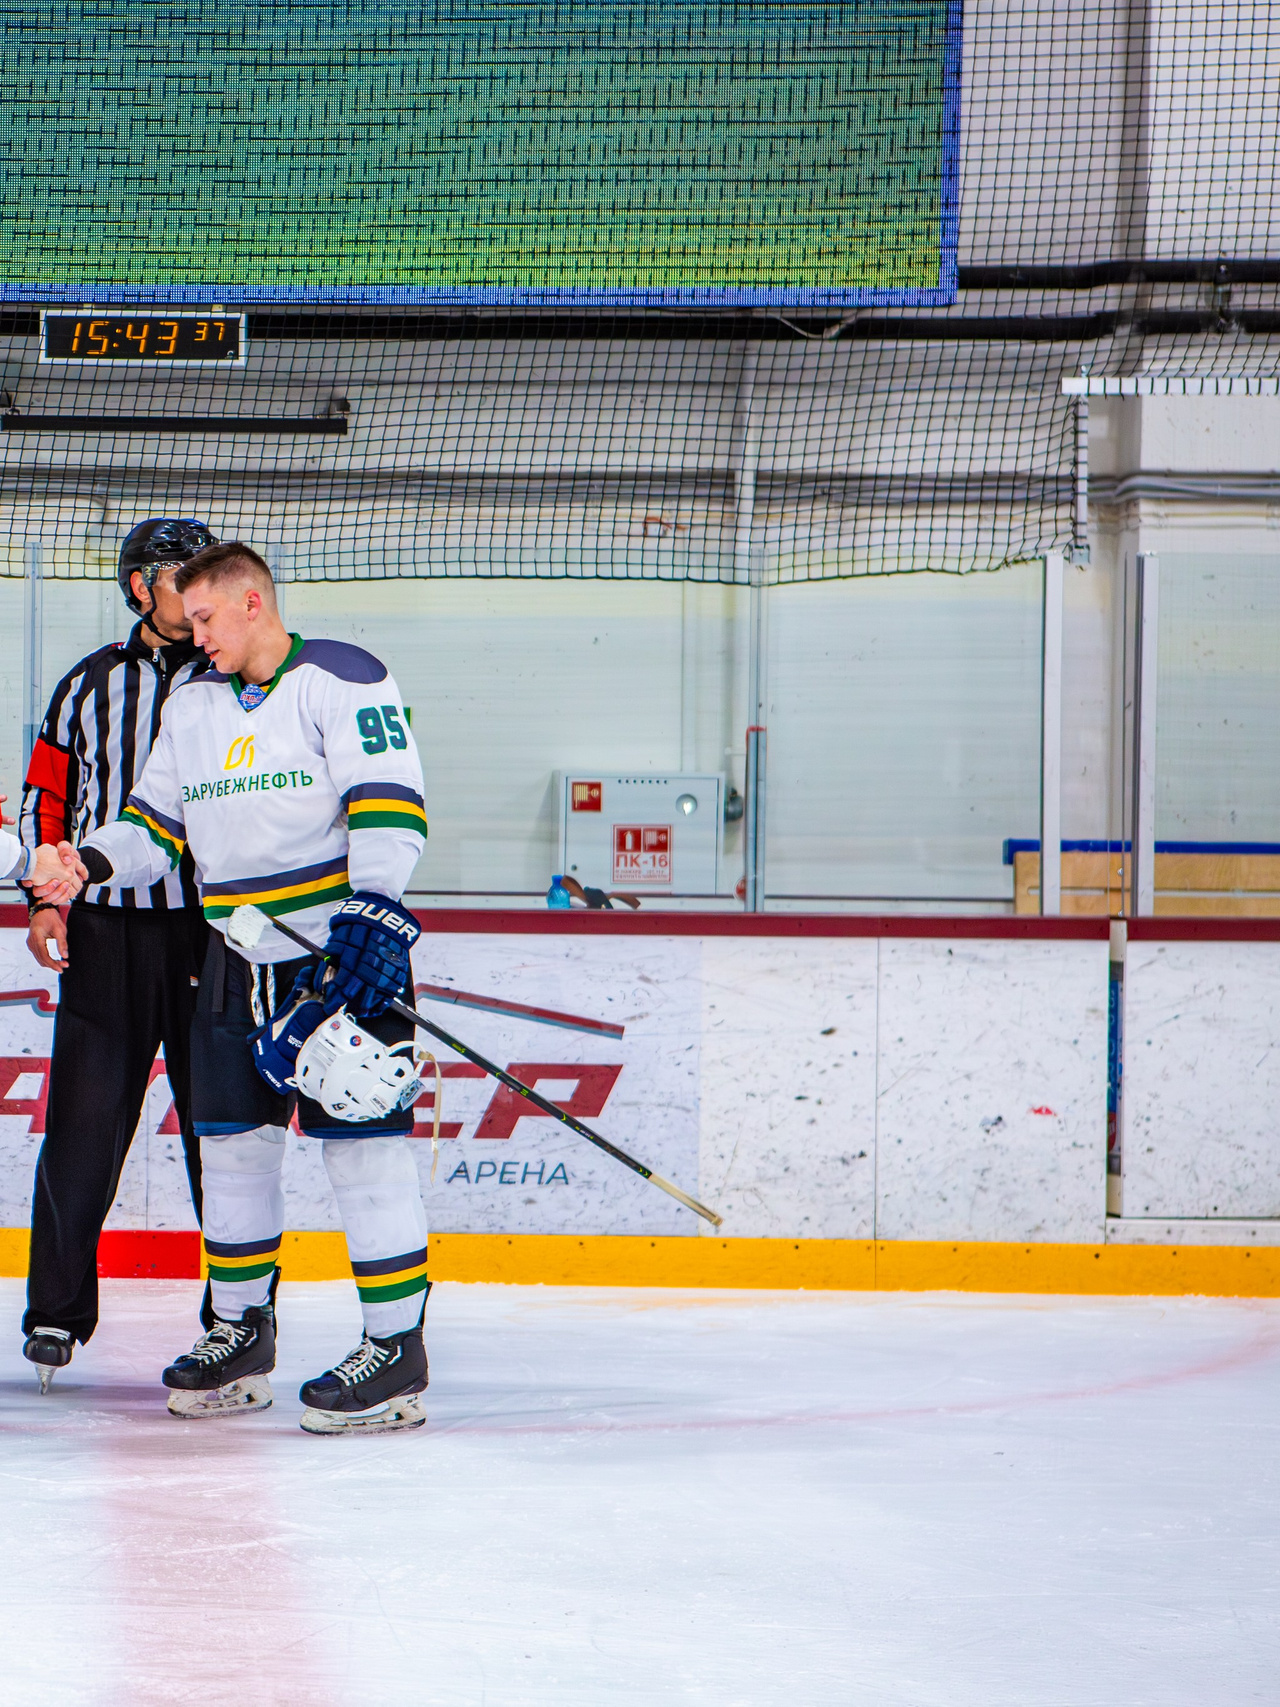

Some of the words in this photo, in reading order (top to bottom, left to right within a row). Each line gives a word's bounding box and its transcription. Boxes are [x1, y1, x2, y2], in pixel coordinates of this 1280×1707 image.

[71, 320, 179, 355] 15:43
[193, 322, 226, 341] 37
[355, 705, 408, 756] 95
[182, 769, 314, 803] ЗАРУБЕЖНЕФТЬ
[447, 1160, 570, 1186] АРЕНА
